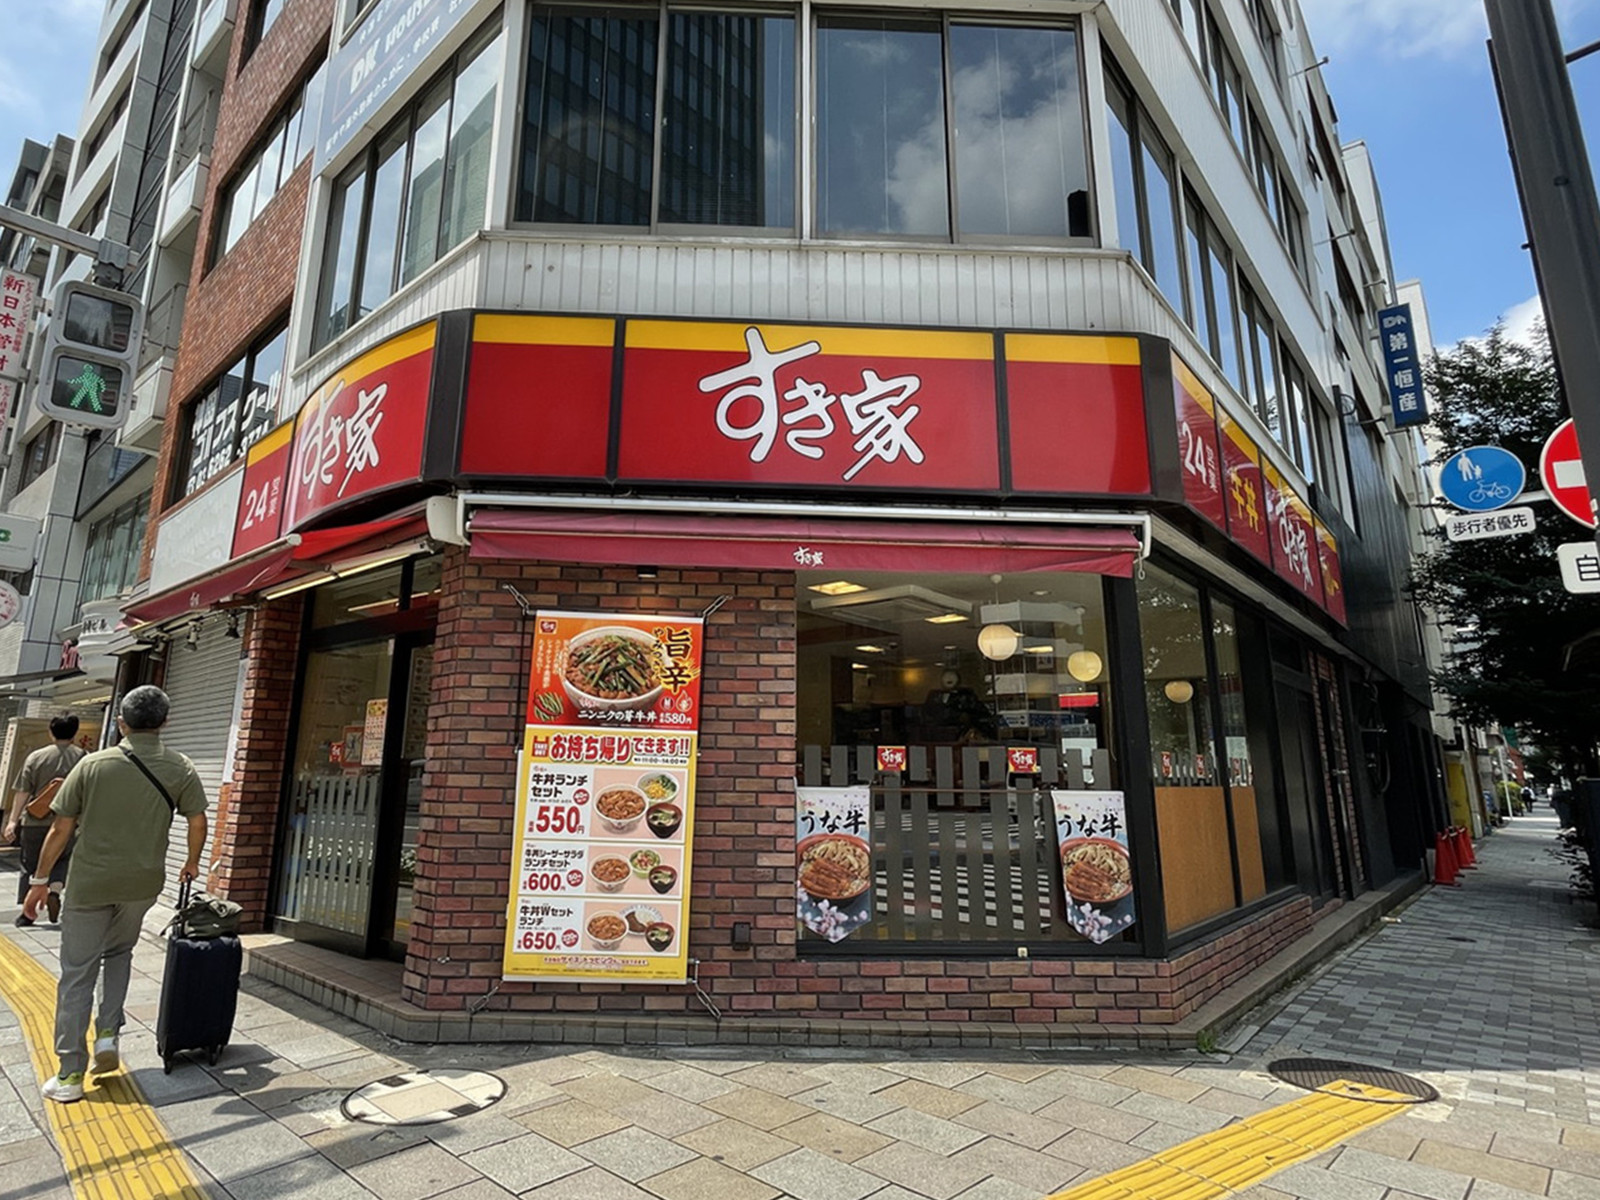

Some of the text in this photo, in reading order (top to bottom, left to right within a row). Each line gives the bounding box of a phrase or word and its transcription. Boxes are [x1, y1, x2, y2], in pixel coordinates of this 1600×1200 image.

[1390, 332, 1418, 412] 第一恒産
[698, 326, 925, 482] すき家
[301, 379, 388, 499] すき家
[1182, 421, 1207, 485] 24
[242, 481, 269, 530] 24
[1274, 477, 1313, 591] すき家
[1453, 514, 1528, 536] 歩行者優先
[793, 547, 824, 566] すき家
[661, 627, 692, 694] 旨辛
[577, 709, 657, 722] ニンニクの芽牛丼
[532, 773, 588, 786] 牛丼ランチ
[531, 786, 562, 798] セット
[801, 810, 866, 834] うな牛
[1058, 814, 1122, 838] うな牛
[525, 848, 584, 859] 牛丼シーザーサラダ
[525, 858, 571, 868] ランチセット
[520, 917, 544, 926] ランチ
